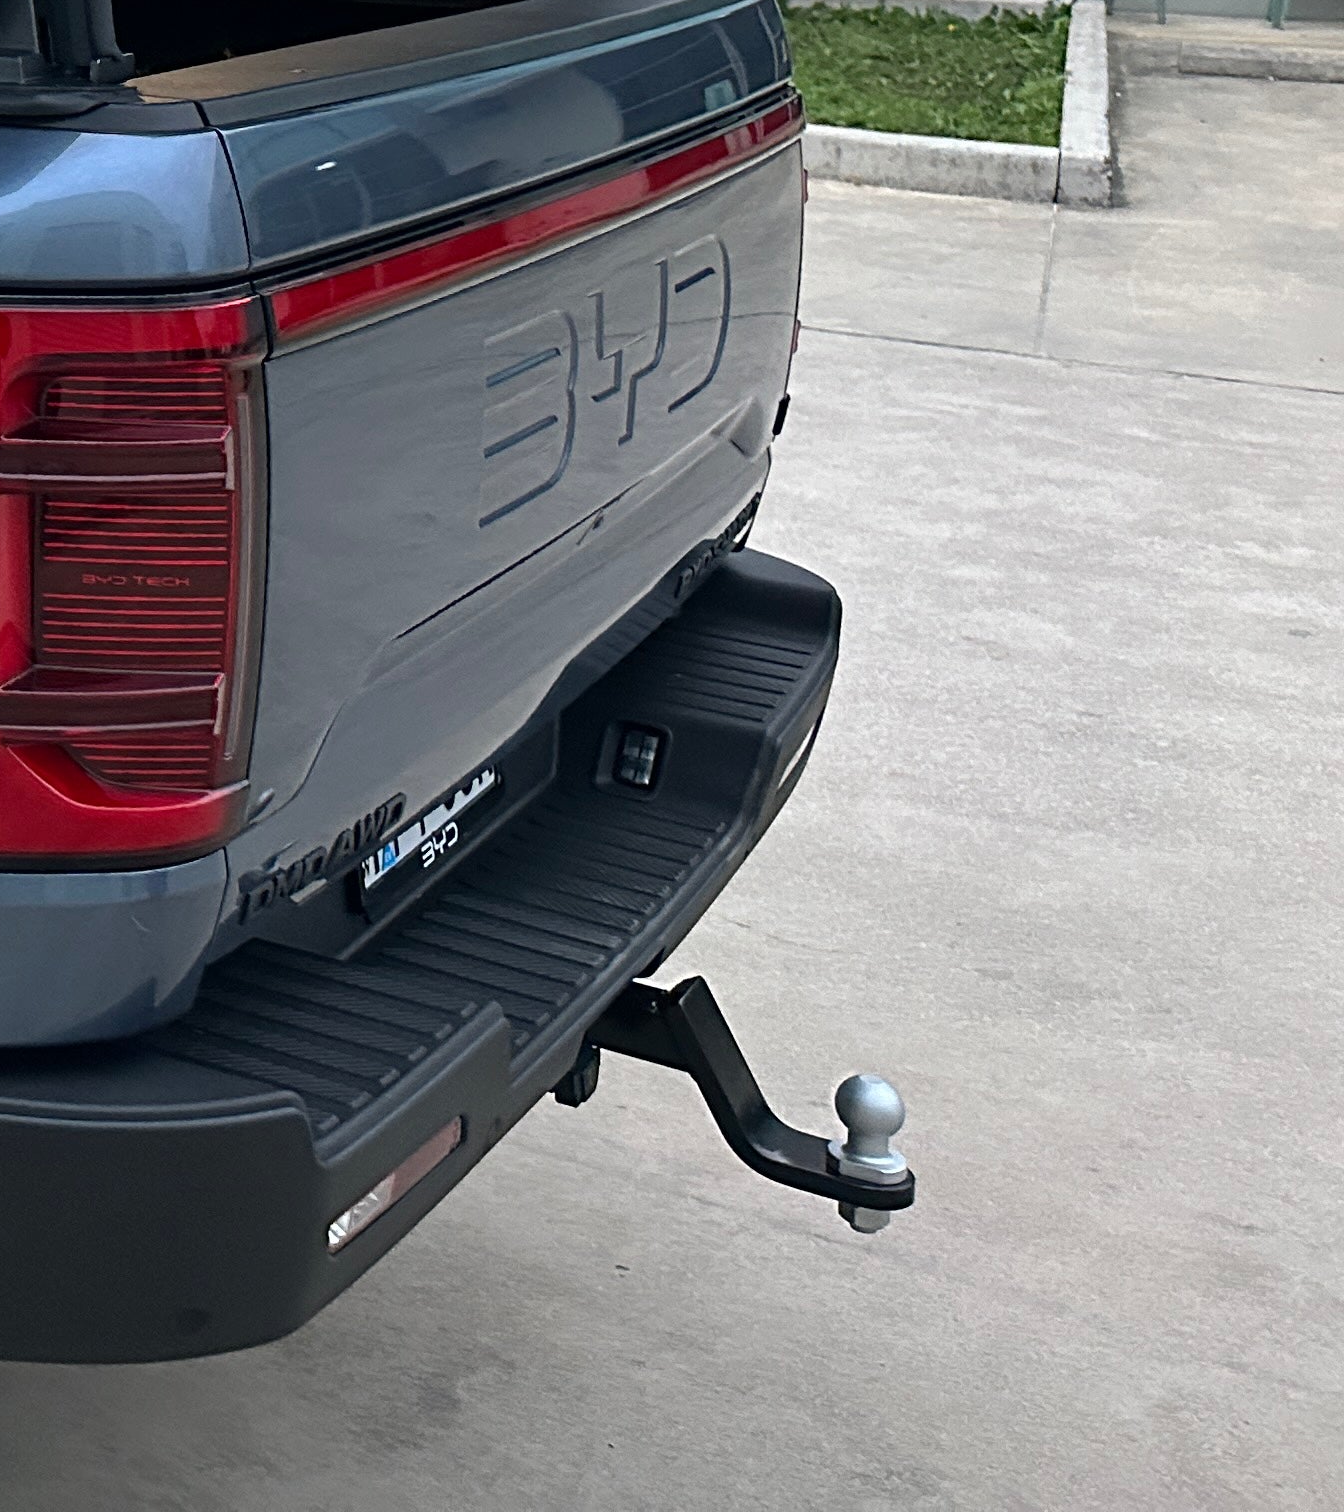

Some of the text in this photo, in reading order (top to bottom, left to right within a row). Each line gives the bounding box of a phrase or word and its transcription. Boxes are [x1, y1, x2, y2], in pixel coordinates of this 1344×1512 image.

[477, 233, 732, 529] BYD
[80, 572, 191, 587] BYD TECH
[421, 821, 460, 869] BYD
